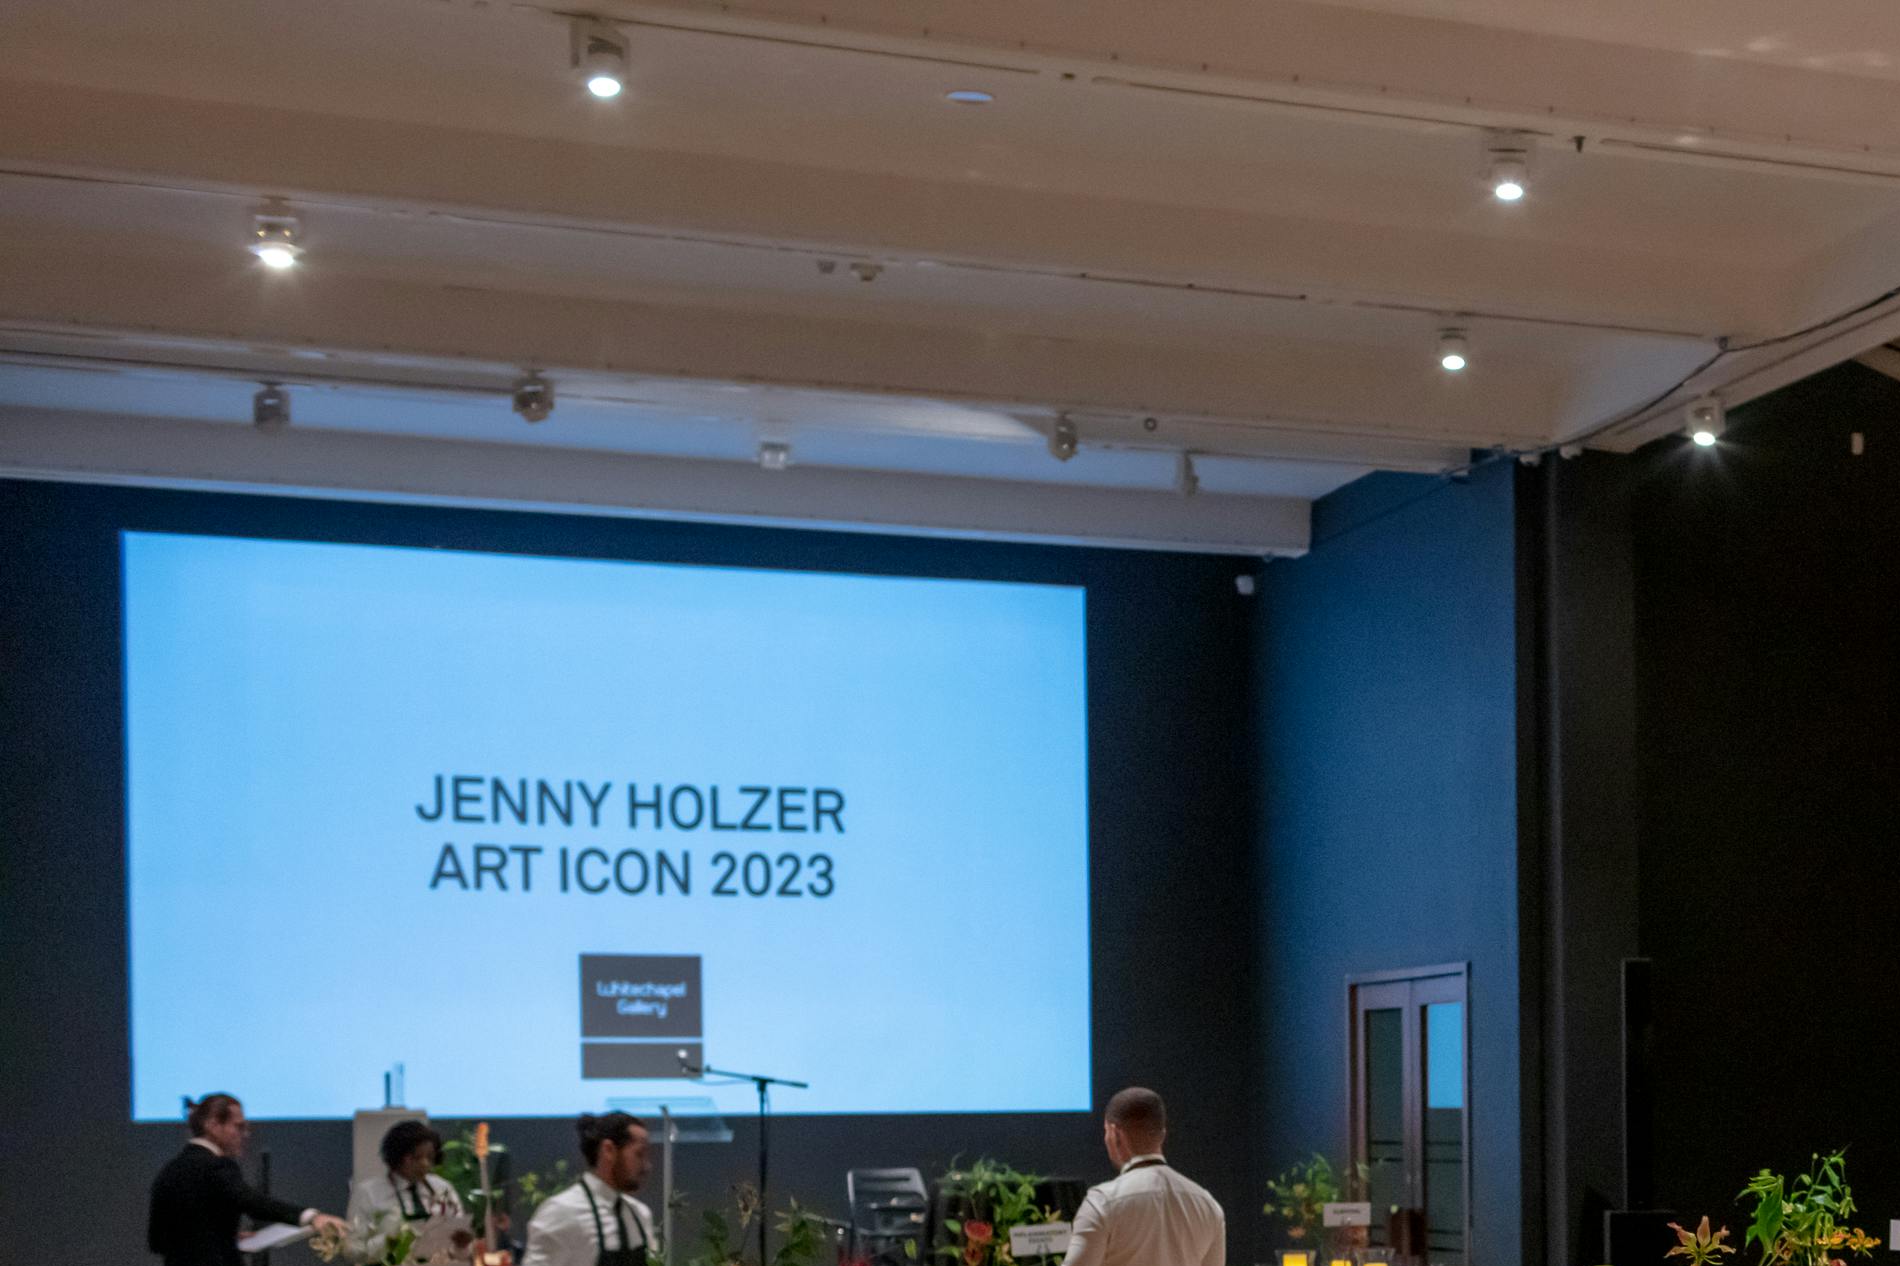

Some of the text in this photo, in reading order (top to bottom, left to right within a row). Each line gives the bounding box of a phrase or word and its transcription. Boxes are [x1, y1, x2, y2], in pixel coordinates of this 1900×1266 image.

[415, 773, 846, 834] JENNY HOLZER
[428, 842, 836, 899] ART ICON 2023
[596, 981, 687, 1000] Whitechapel
[616, 998, 668, 1019] Gallery
